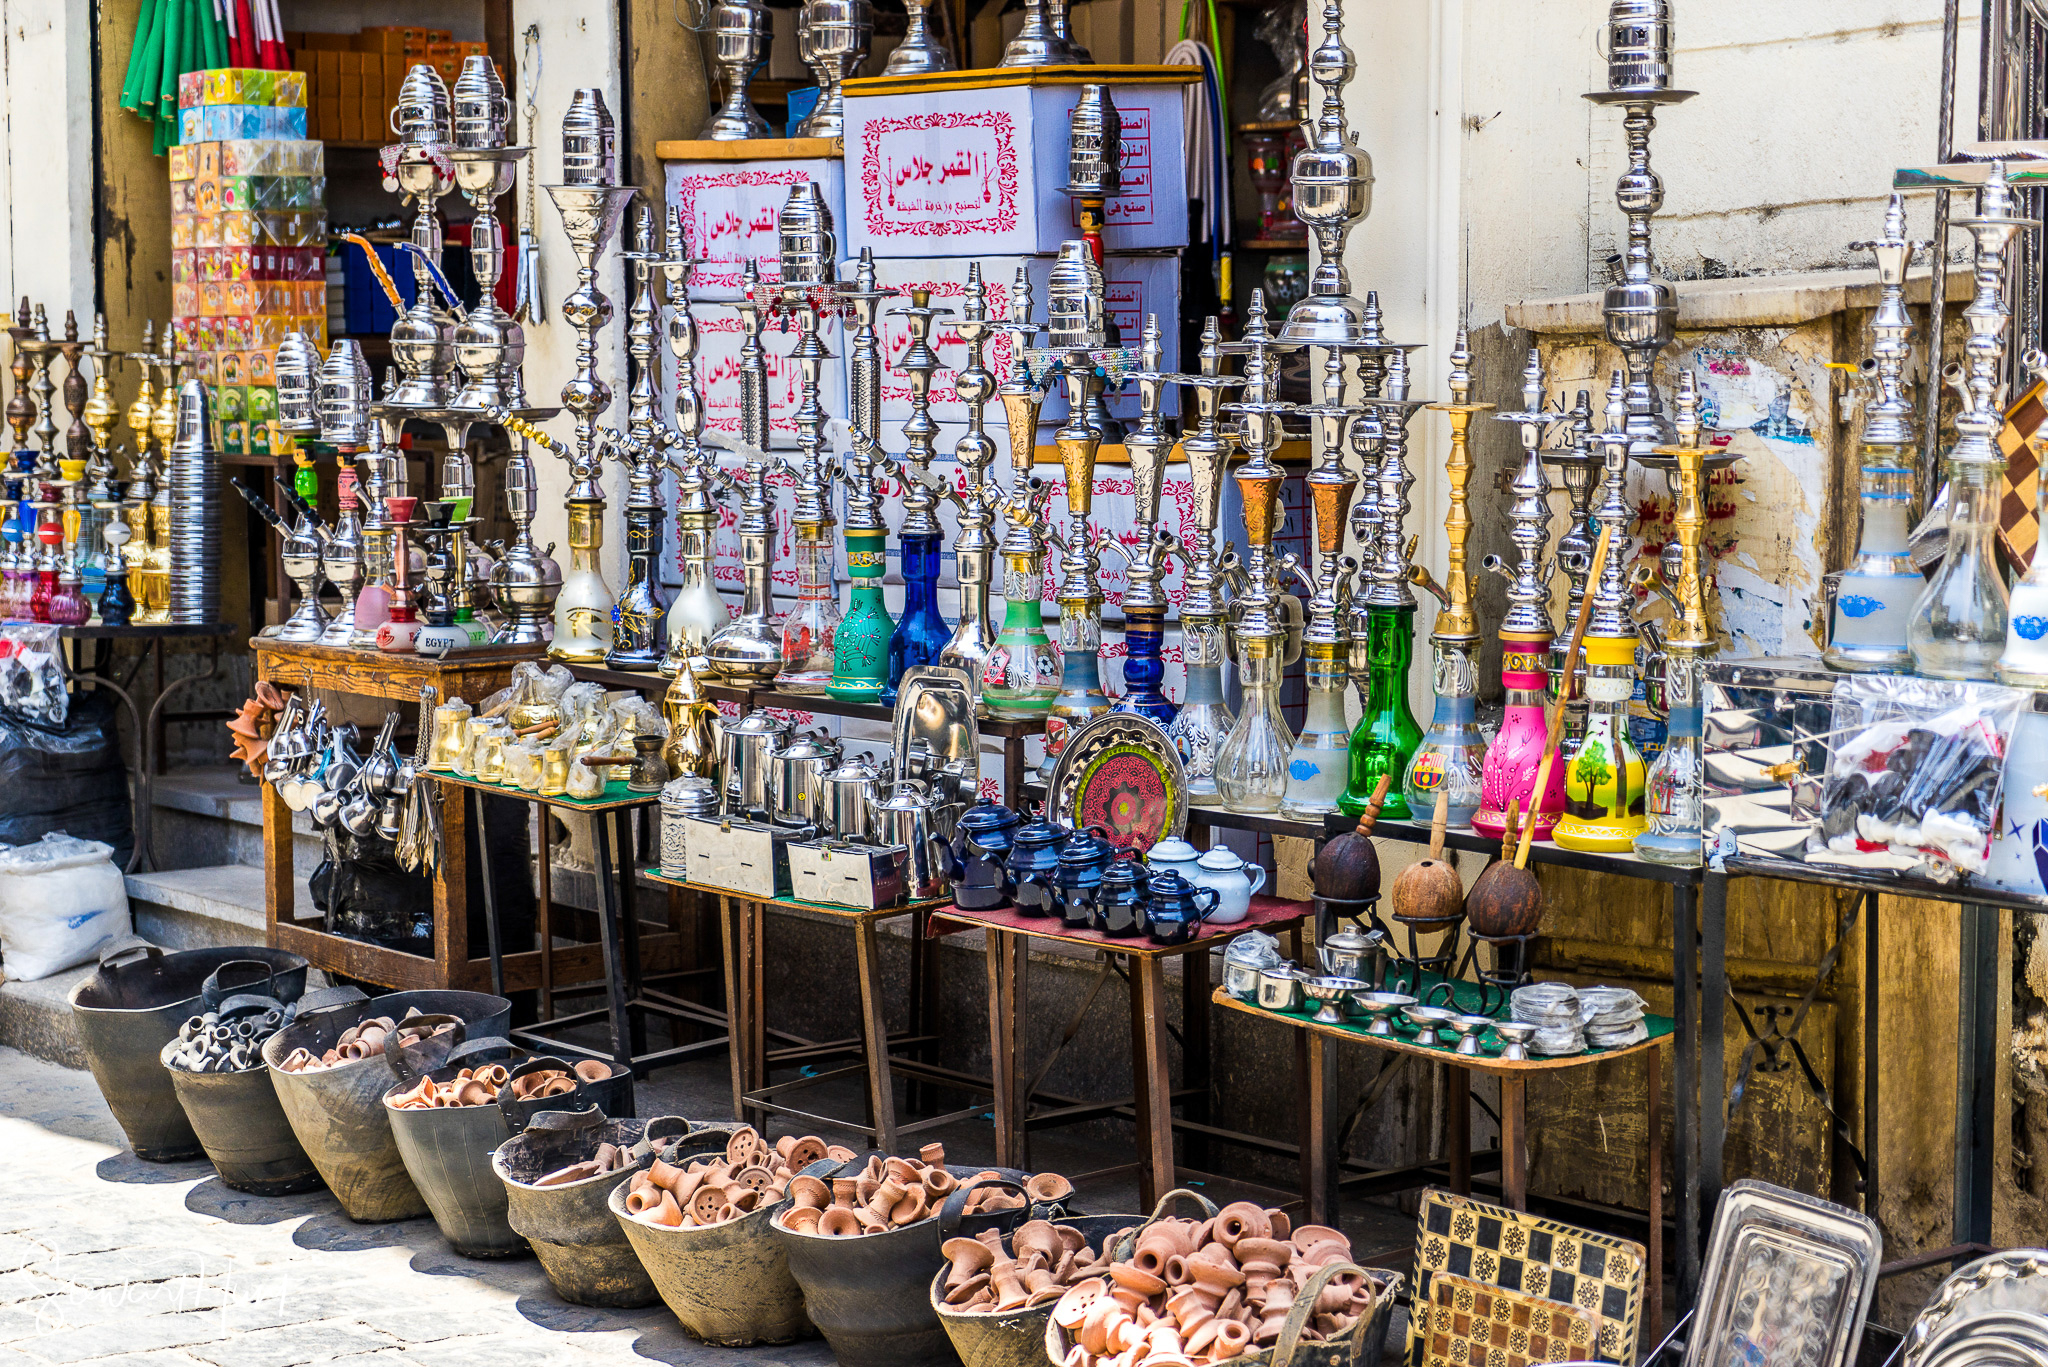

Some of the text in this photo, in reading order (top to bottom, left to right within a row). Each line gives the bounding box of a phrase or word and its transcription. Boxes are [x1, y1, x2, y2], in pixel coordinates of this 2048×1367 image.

[896, 148, 979, 187] القمر جلاس
[896, 198, 923, 215] الشيشة
[954, 196, 981, 216] لتصنيع
[1123, 201, 1146, 217] صنع
[710, 210, 743, 240] جلاس
[425, 638, 455, 649] EGYPT
